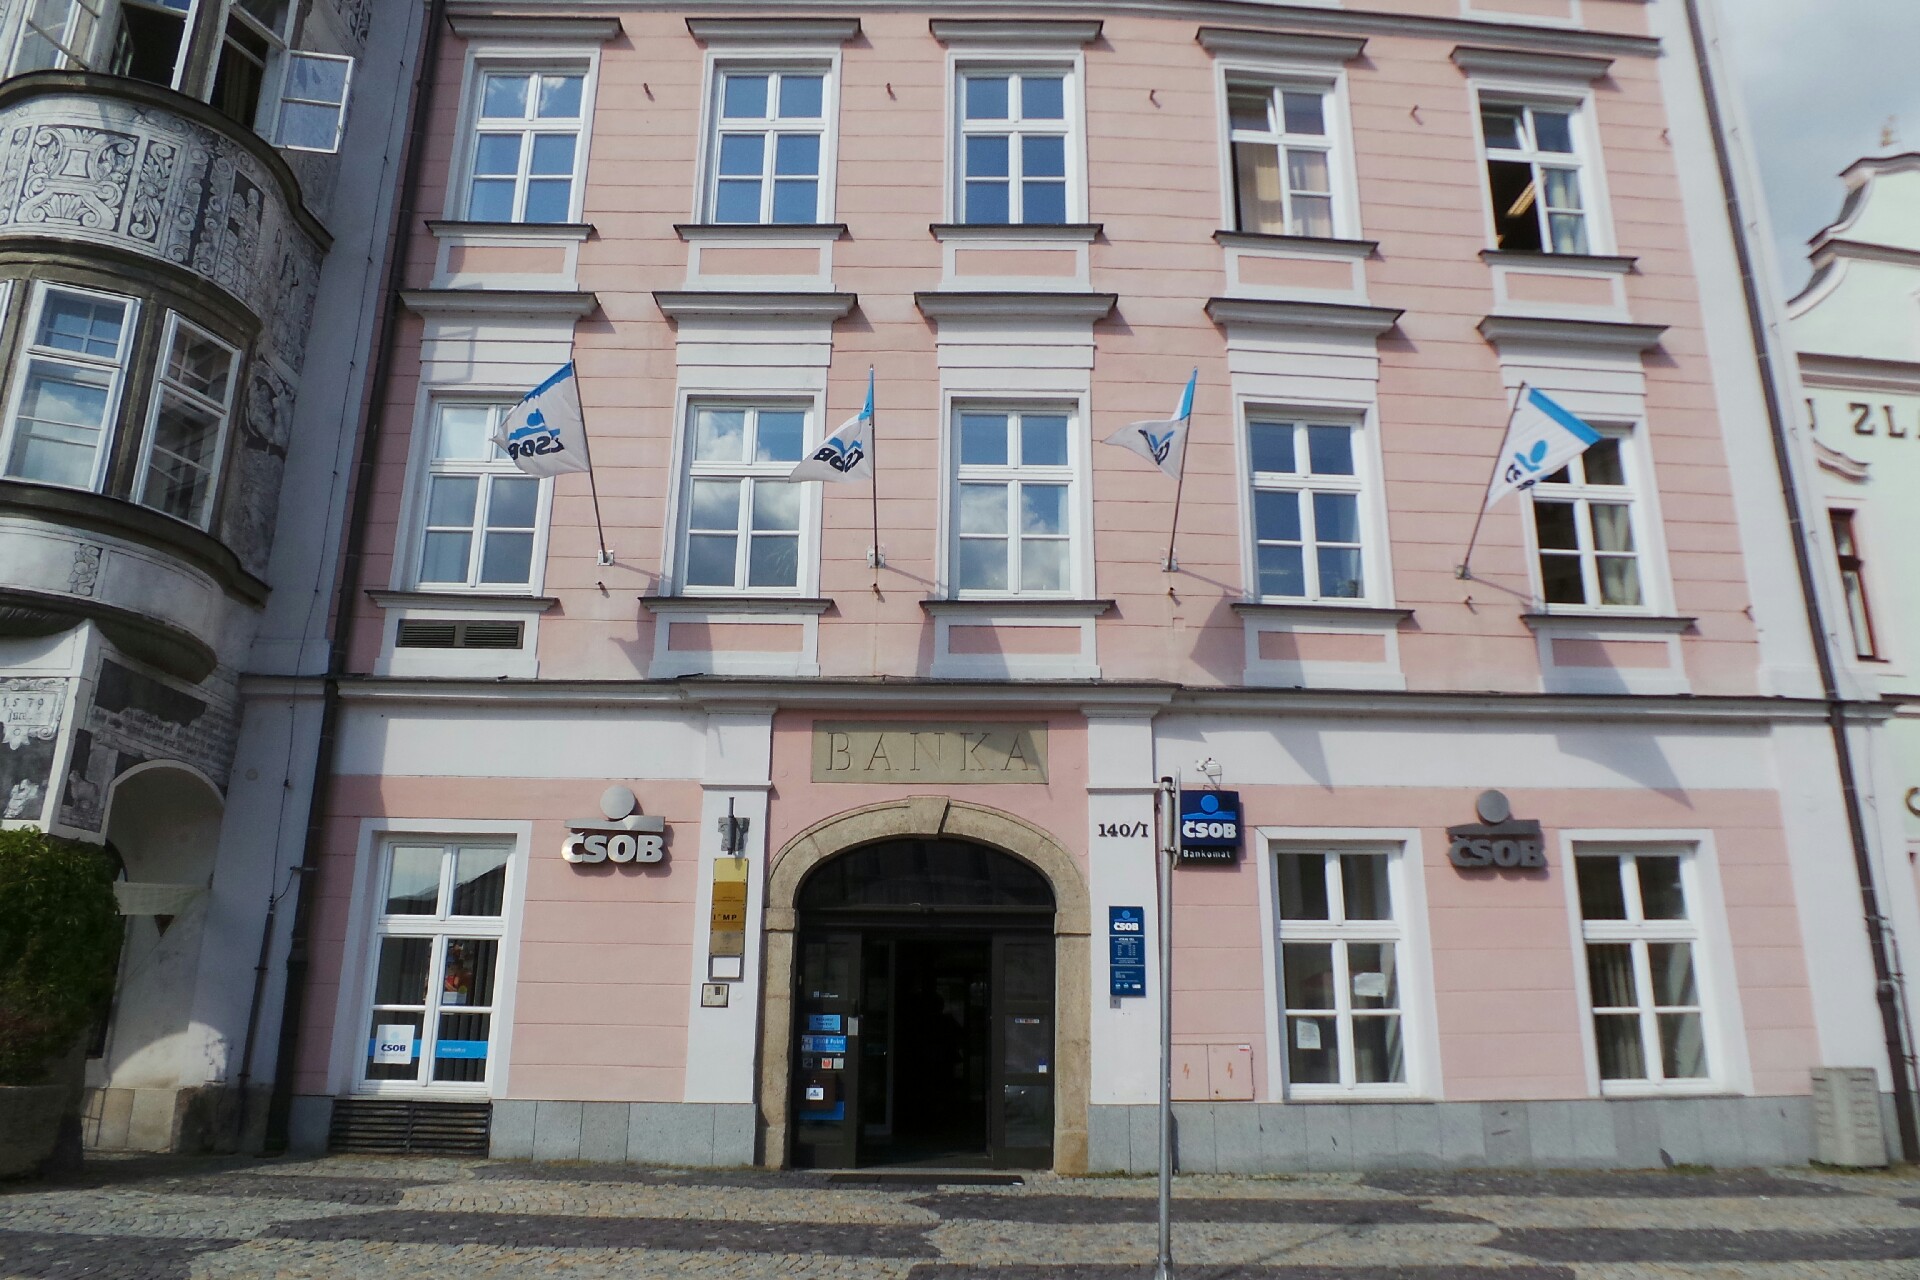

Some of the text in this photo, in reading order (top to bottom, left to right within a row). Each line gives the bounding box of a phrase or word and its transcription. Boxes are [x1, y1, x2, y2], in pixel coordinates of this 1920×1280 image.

[1848, 403, 1920, 439] ZL
[825, 732, 1037, 771] BANKA
[1182, 820, 1237, 839] ČSOB
[561, 832, 663, 863] ČSOB
[1183, 849, 1231, 859] Bankomat
[1449, 834, 1546, 867] ČSOB
[1113, 921, 1139, 931] ČSOB
